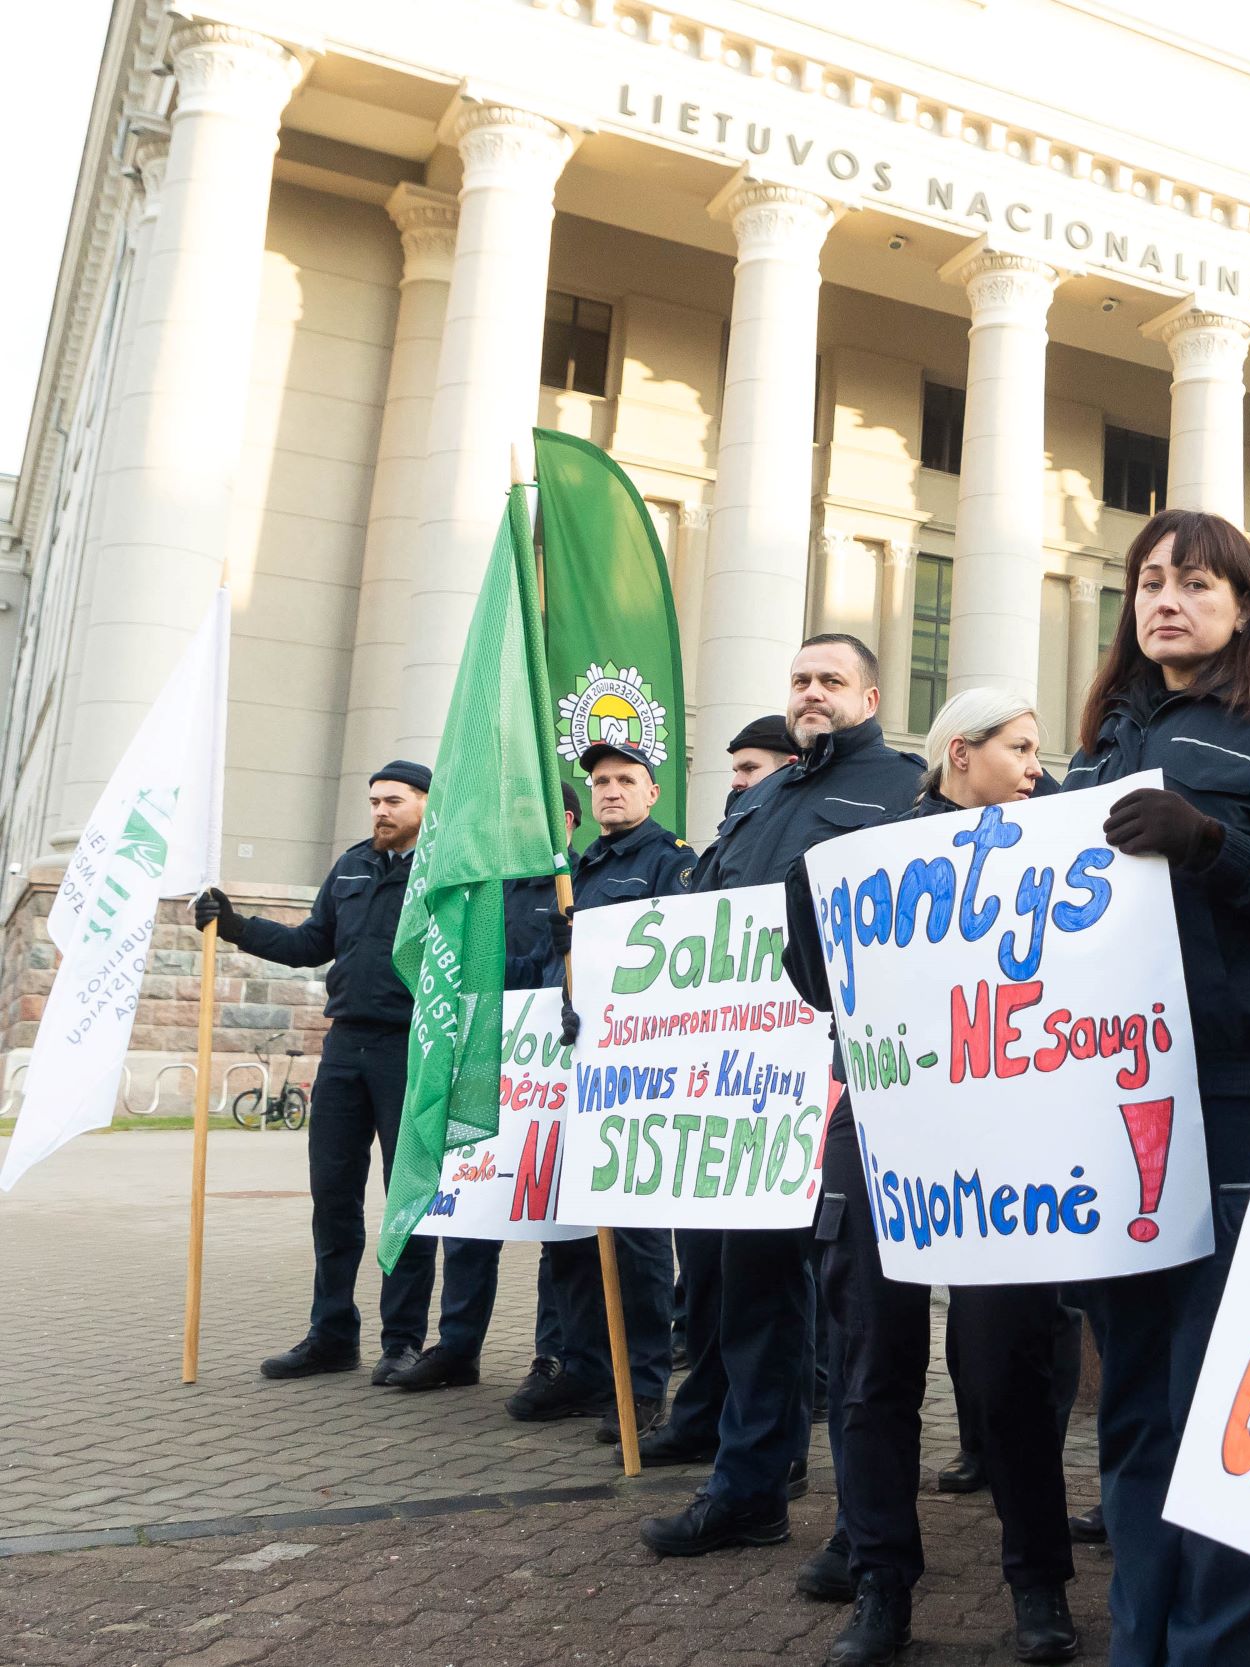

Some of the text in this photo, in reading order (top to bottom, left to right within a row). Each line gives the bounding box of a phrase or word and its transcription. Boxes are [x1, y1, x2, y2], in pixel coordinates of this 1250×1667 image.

[620, 84, 891, 192] LIETUVOS
[814, 805, 1115, 1017] ėgantys
[577, 1061, 677, 1113] VADOVUS
[687, 1061, 710, 1098] iš
